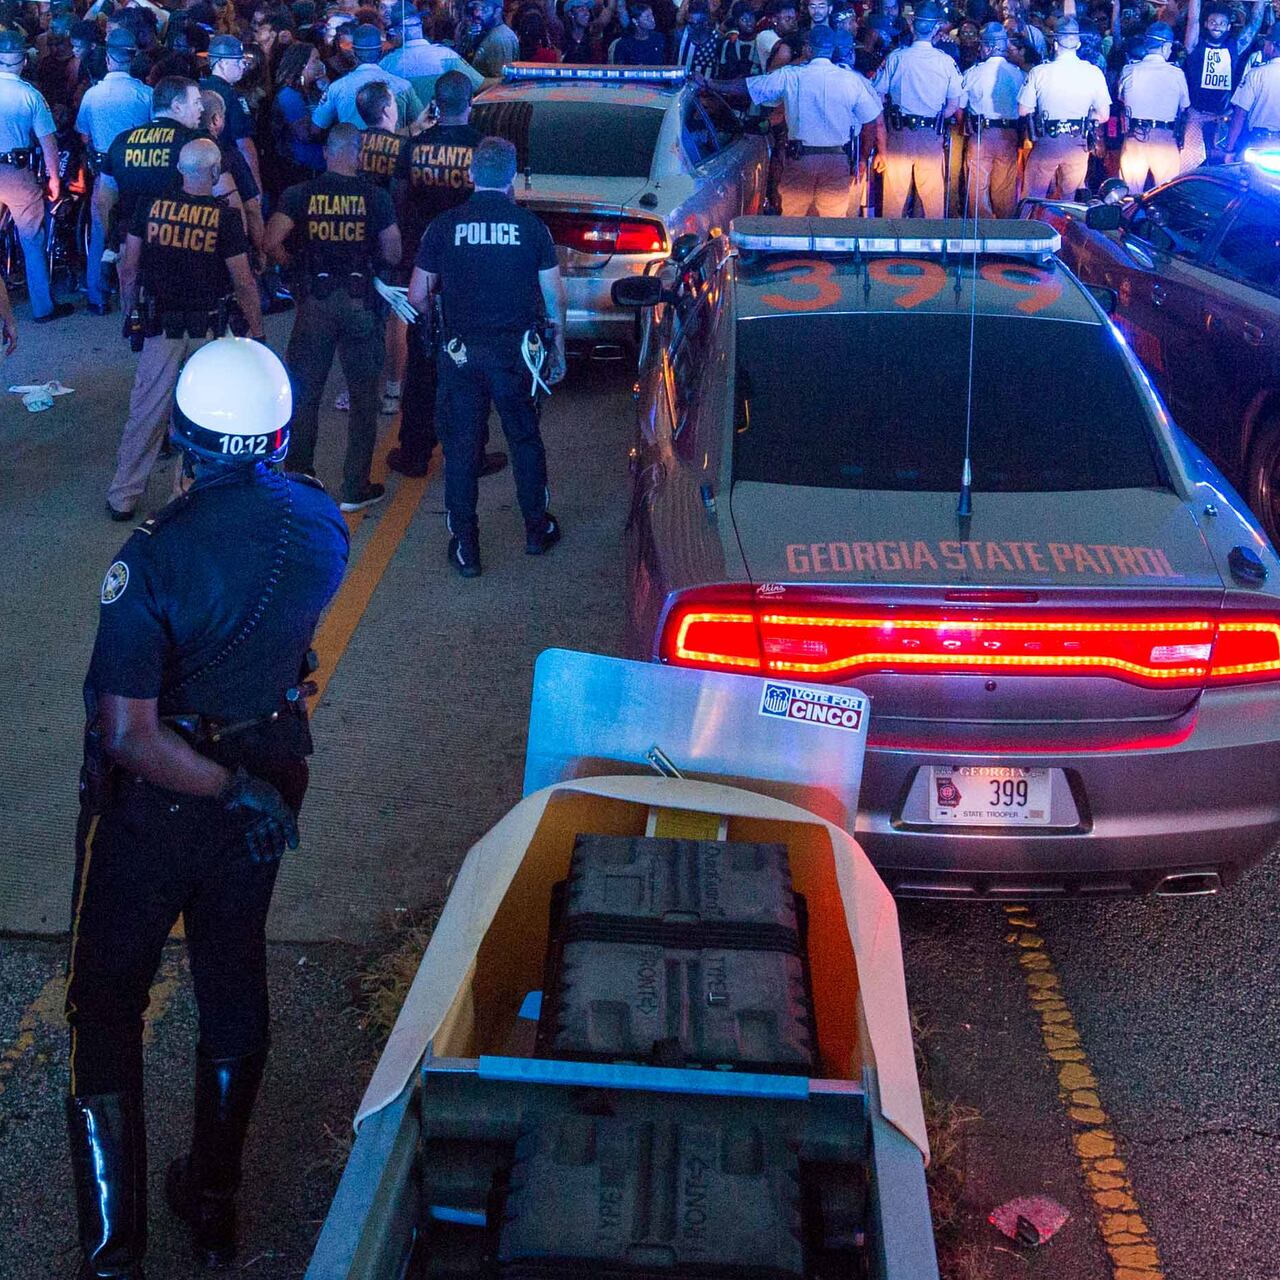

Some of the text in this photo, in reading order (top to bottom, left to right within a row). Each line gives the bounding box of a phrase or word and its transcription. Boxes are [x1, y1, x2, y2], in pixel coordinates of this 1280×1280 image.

[1206, 61, 1216, 74] IS
[1204, 73, 1230, 87] DOPE
[126, 127, 176, 144] ATLANTA
[363, 133, 401, 155] LANTA
[124, 148, 171, 168] POLICE
[361, 152, 397, 176] LICE
[412, 144, 475, 168] ATLANTA
[149, 199, 220, 229] ATLANTA
[307, 193, 367, 216] ATLANTA
[147, 221, 218, 253] POLICE
[308, 221, 366, 242] POLICE
[454, 222, 521, 247] POLICE
[759, 257, 1064, 315] 399
[219, 434, 269, 455] 1012
[786, 540, 1178, 577] GEORGIA STATE PATROL
[756, 583, 787, 595] Akins
[794, 687, 859, 709] VOTE FOR
[790, 701, 858, 727] CINCO
[959, 766, 1025, 777] GEORGIA
[989, 779, 1029, 807] 399
[963, 810, 1019, 818] STATE TROOPER
